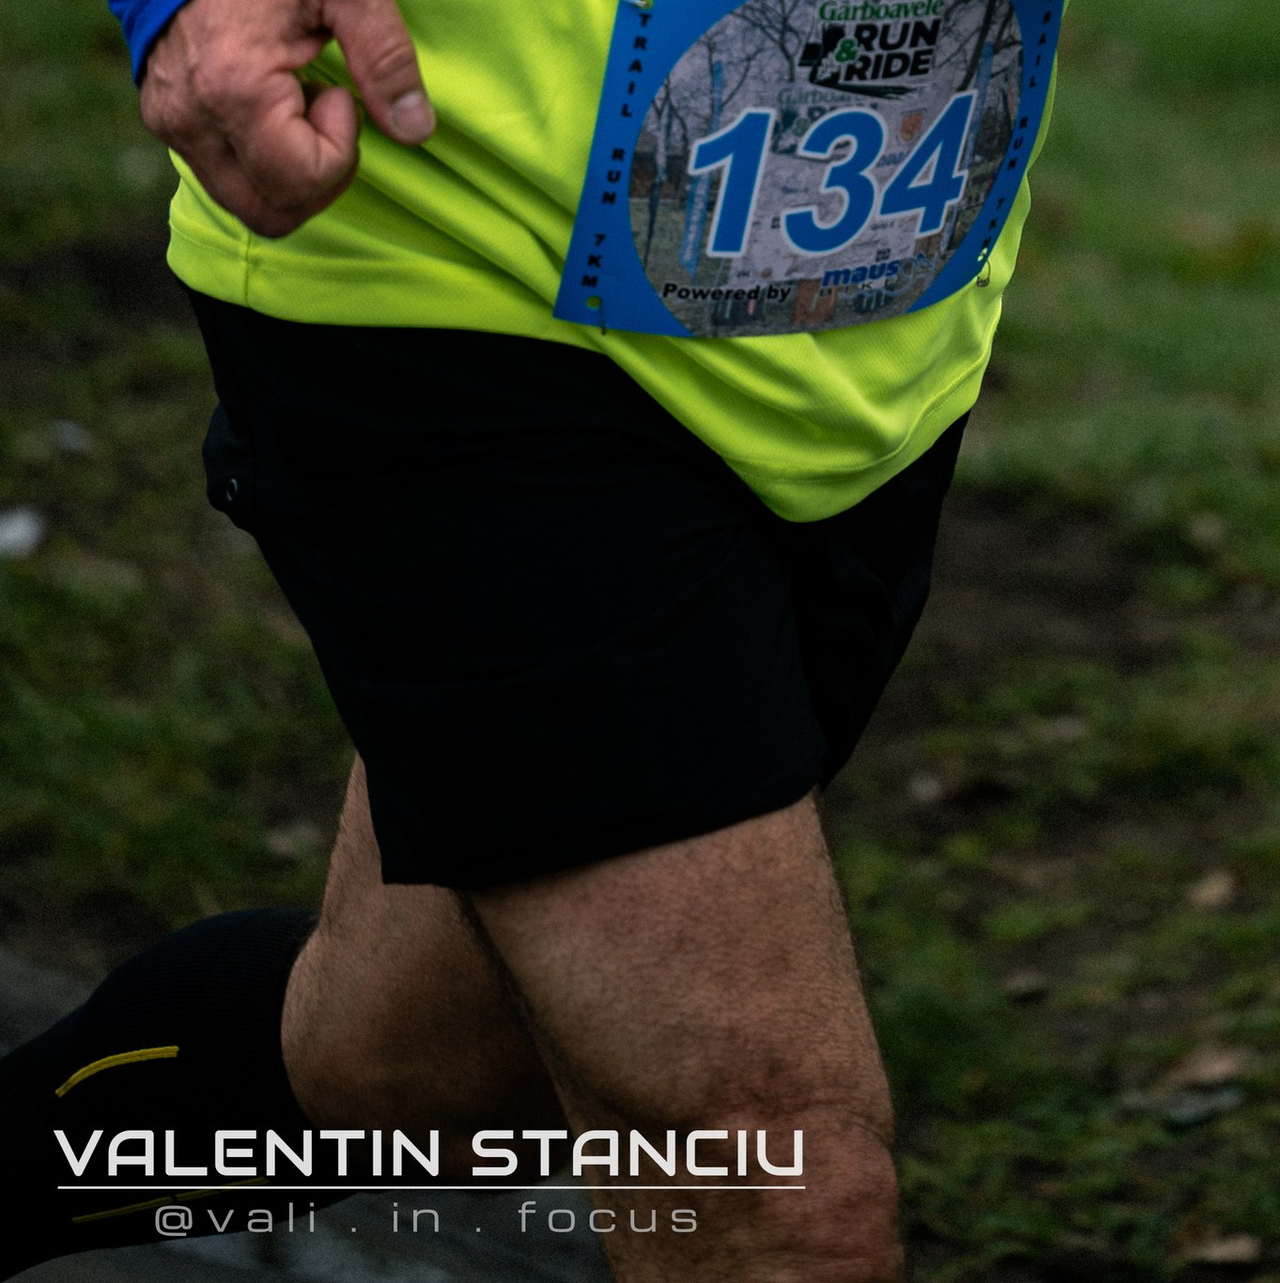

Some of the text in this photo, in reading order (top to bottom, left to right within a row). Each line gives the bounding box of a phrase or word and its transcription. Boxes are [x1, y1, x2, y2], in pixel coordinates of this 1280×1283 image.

[854, 19, 941, 52] RUN
[620, 13, 652, 118] TRAIL
[843, 49, 934, 82] RIDE
[602, 148, 625, 205] RUN
[688, 89, 978, 257] 134
[822, 259, 901, 287] maus
[662, 283, 792, 303] Powered by
